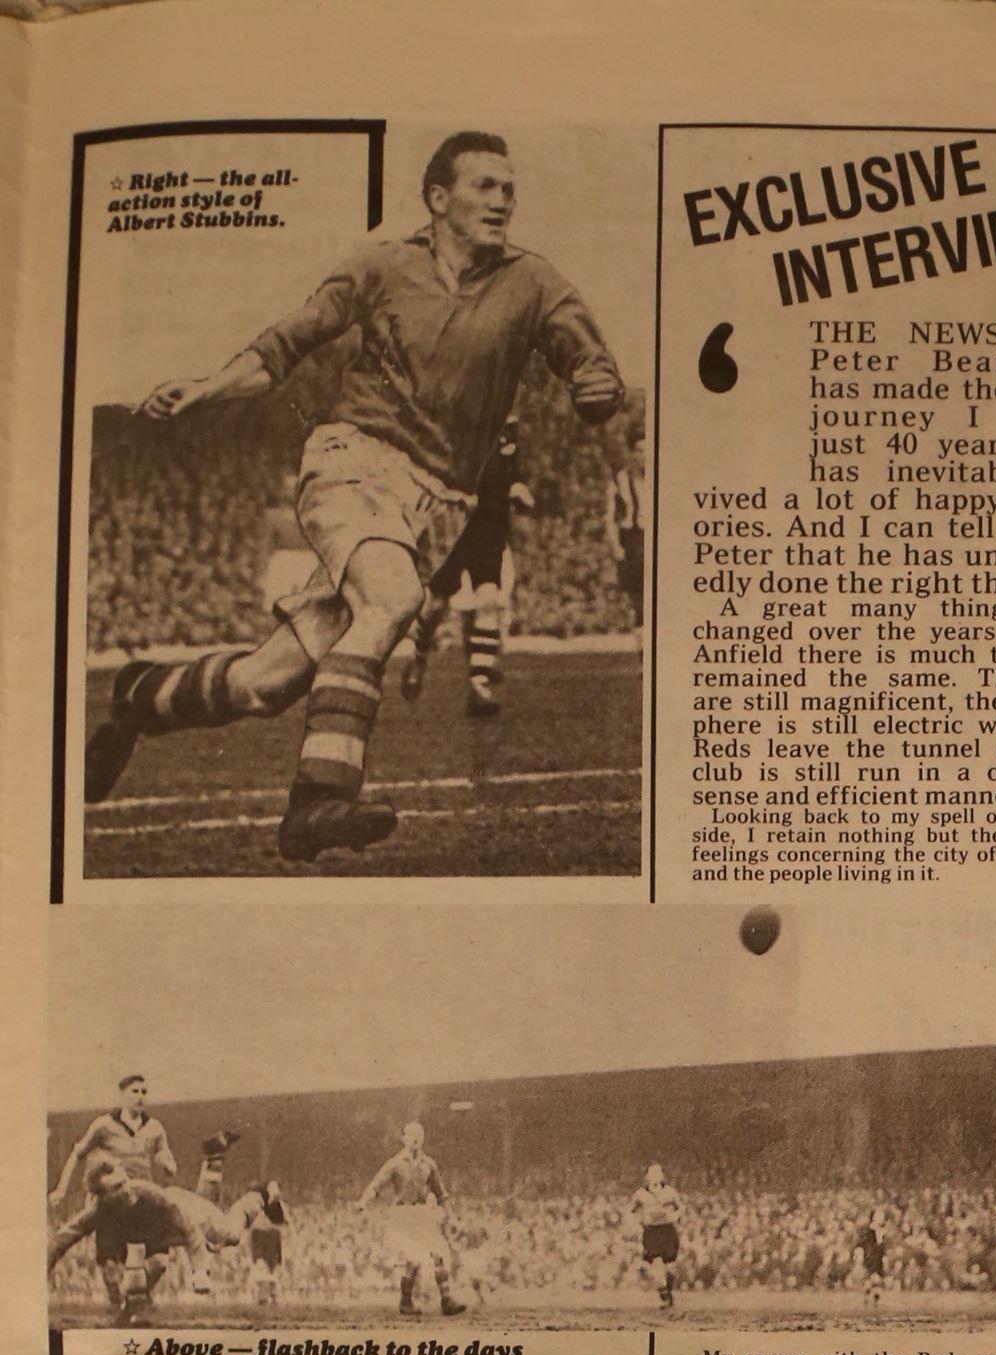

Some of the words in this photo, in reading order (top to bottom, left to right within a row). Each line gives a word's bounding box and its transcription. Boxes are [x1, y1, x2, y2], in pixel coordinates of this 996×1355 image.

[128, 170, 190, 191] Right
[219, 169, 257, 187] the
[260, 168, 299, 187] all-
[107, 193, 176, 214] action
[179, 189, 236, 212] style
[239, 189, 264, 211] of
[683, 139, 988, 247] EXCLUSIVE
[106, 213, 176, 234] Albert
[179, 210, 286, 229] Stubbins.
[809, 320, 876, 344] THE
[810, 348, 900, 372] Peter
[809, 375, 860, 400] has
[872, 376, 950, 401] made
[808, 402, 935, 434] journey
[968, 405, 979, 428] I
[808, 434, 866, 462] just
[886, 431, 918, 455] 40
[719, 596, 740, 617] A
[762, 599, 827, 621] great
[851, 602, 917, 622] many
[692, 845, 769, 866] feelings
[777, 849, 886, 866] concerning
[894, 844, 926, 863] the
[933, 847, 969, 866] city
[692, 864, 728, 882] and
[733, 864, 765, 882] the
[769, 864, 833, 885] people
[837, 864, 892, 885] living
[897, 865, 915, 882] in
[920, 866, 940, 881] it.
